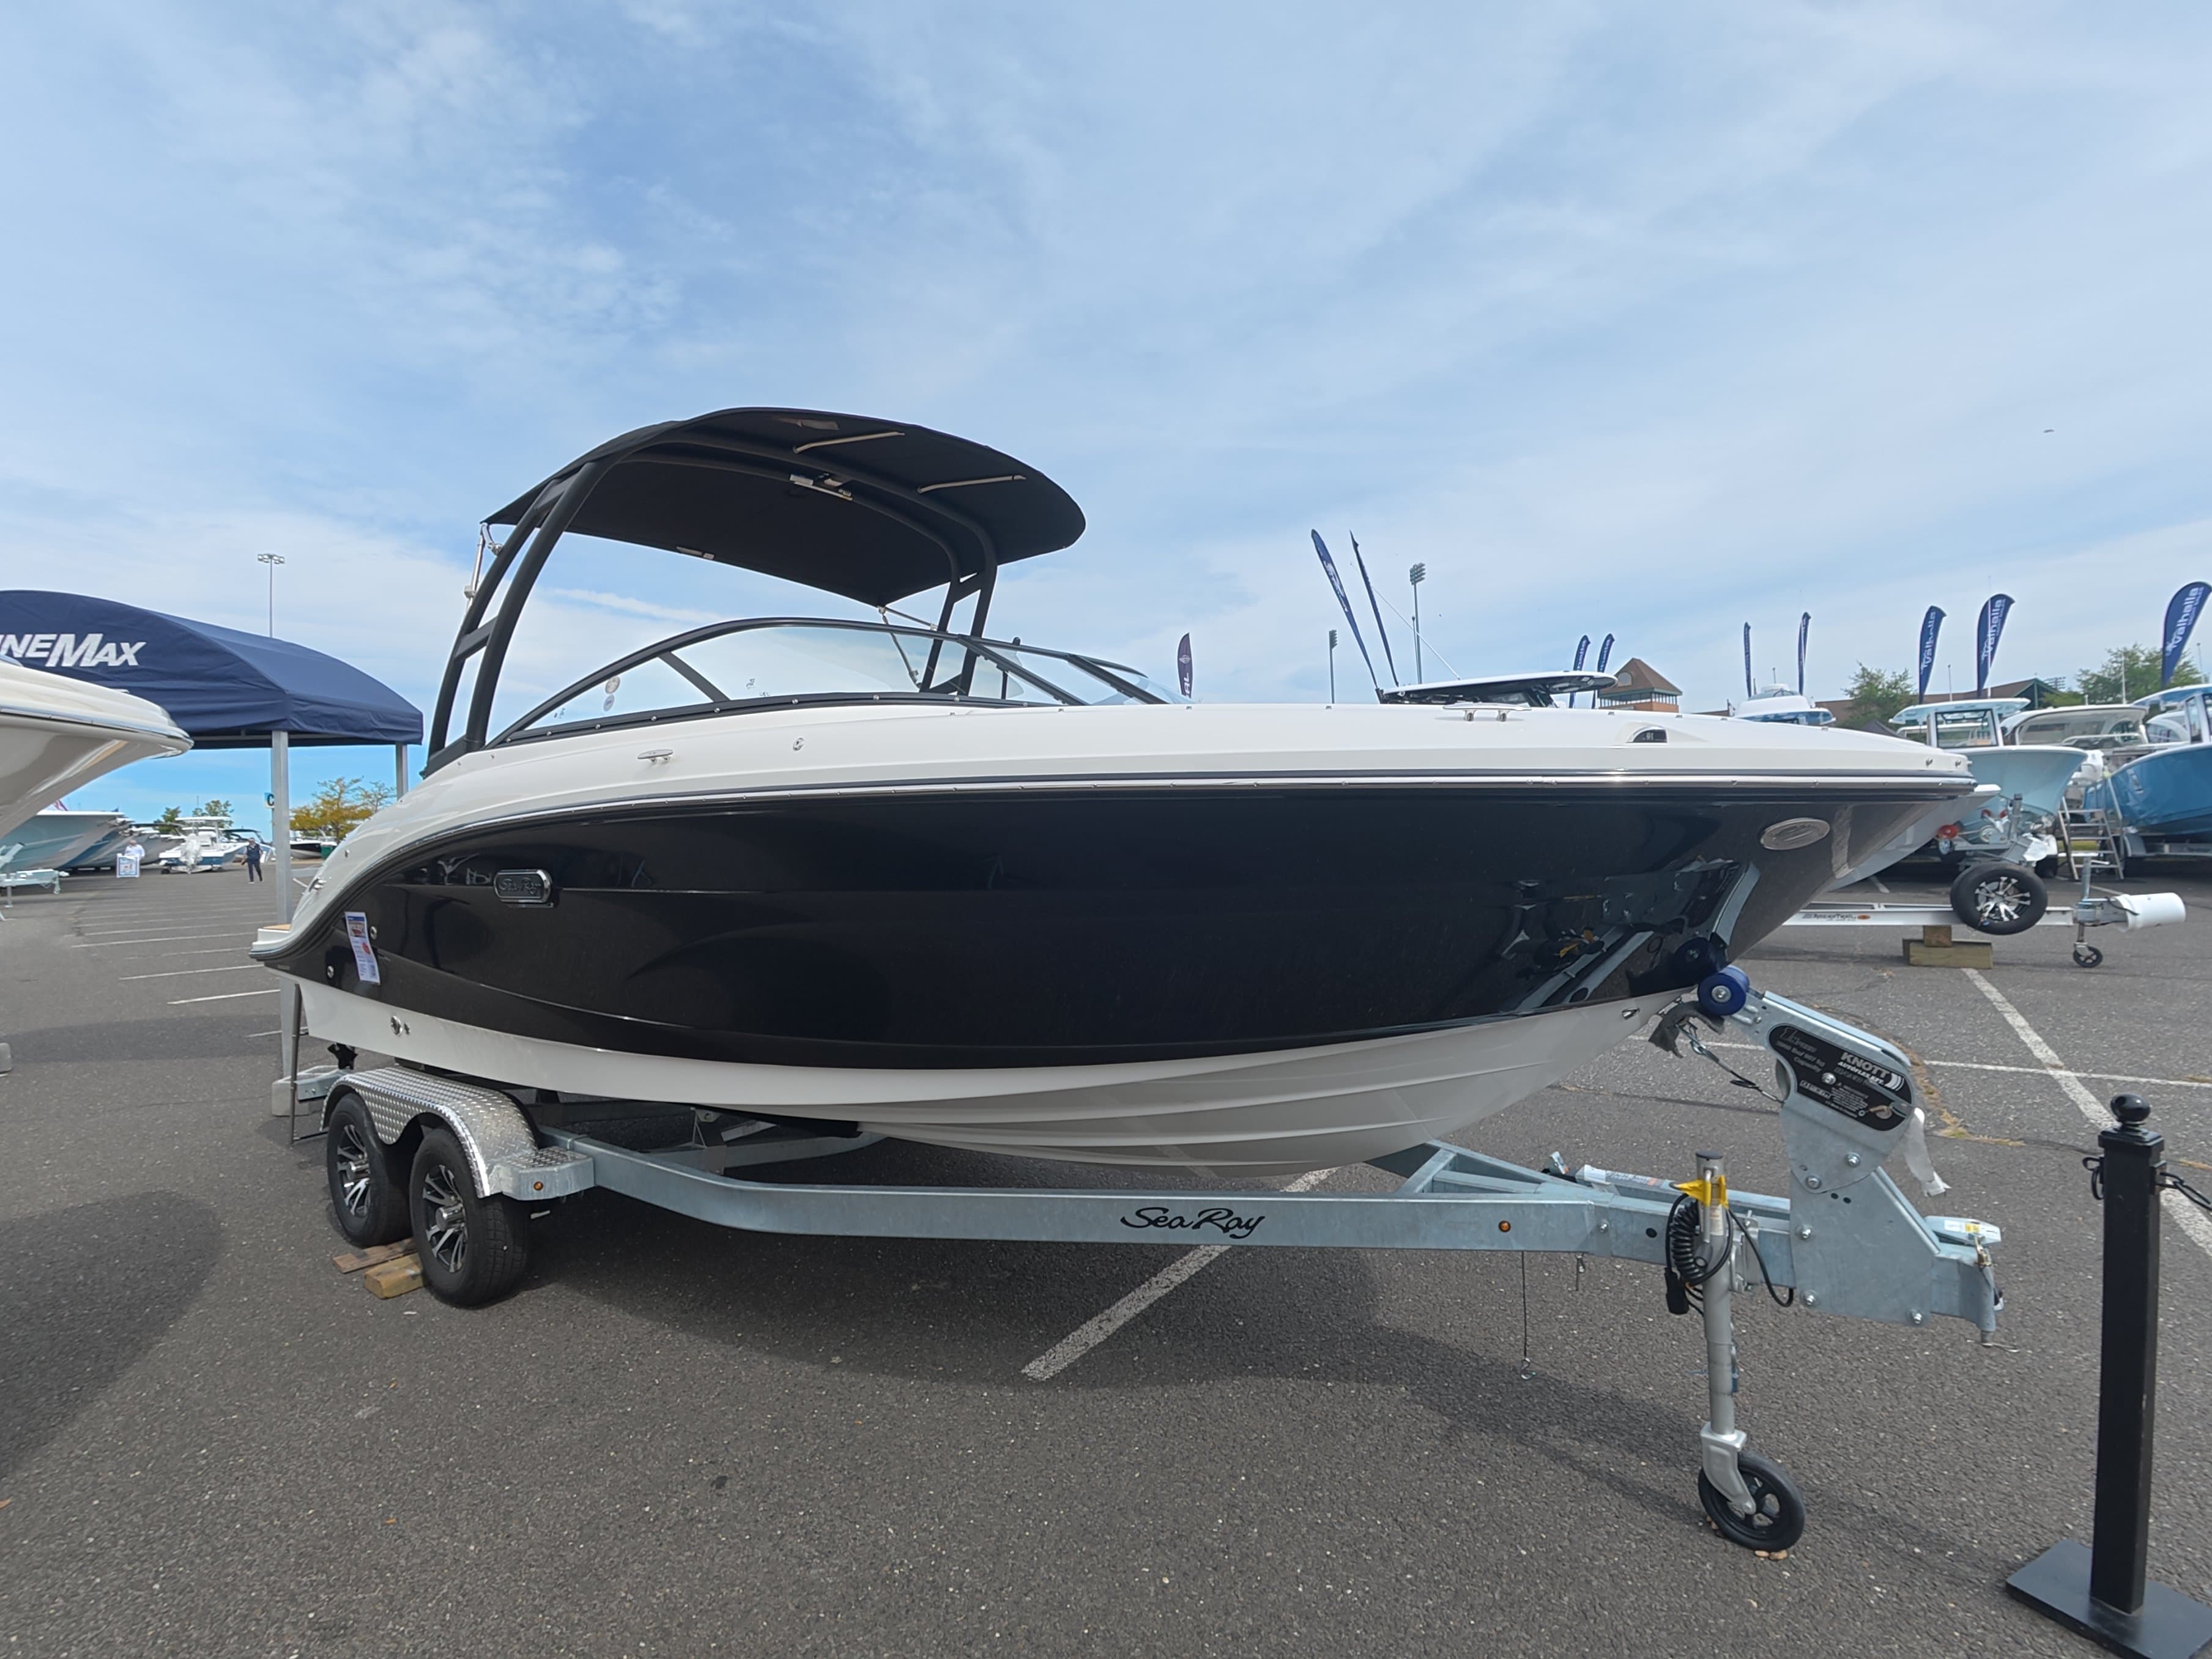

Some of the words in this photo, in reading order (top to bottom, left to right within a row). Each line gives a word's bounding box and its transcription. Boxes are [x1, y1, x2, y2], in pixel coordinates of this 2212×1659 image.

[1986, 599, 2002, 651] Valhalla
[2172, 587, 2199, 642] Valhalla
[1841, 1052, 1890, 1078] KNOTT
[1120, 1207, 1193, 1229] Sea
[1192, 1208, 1265, 1239] Ray
